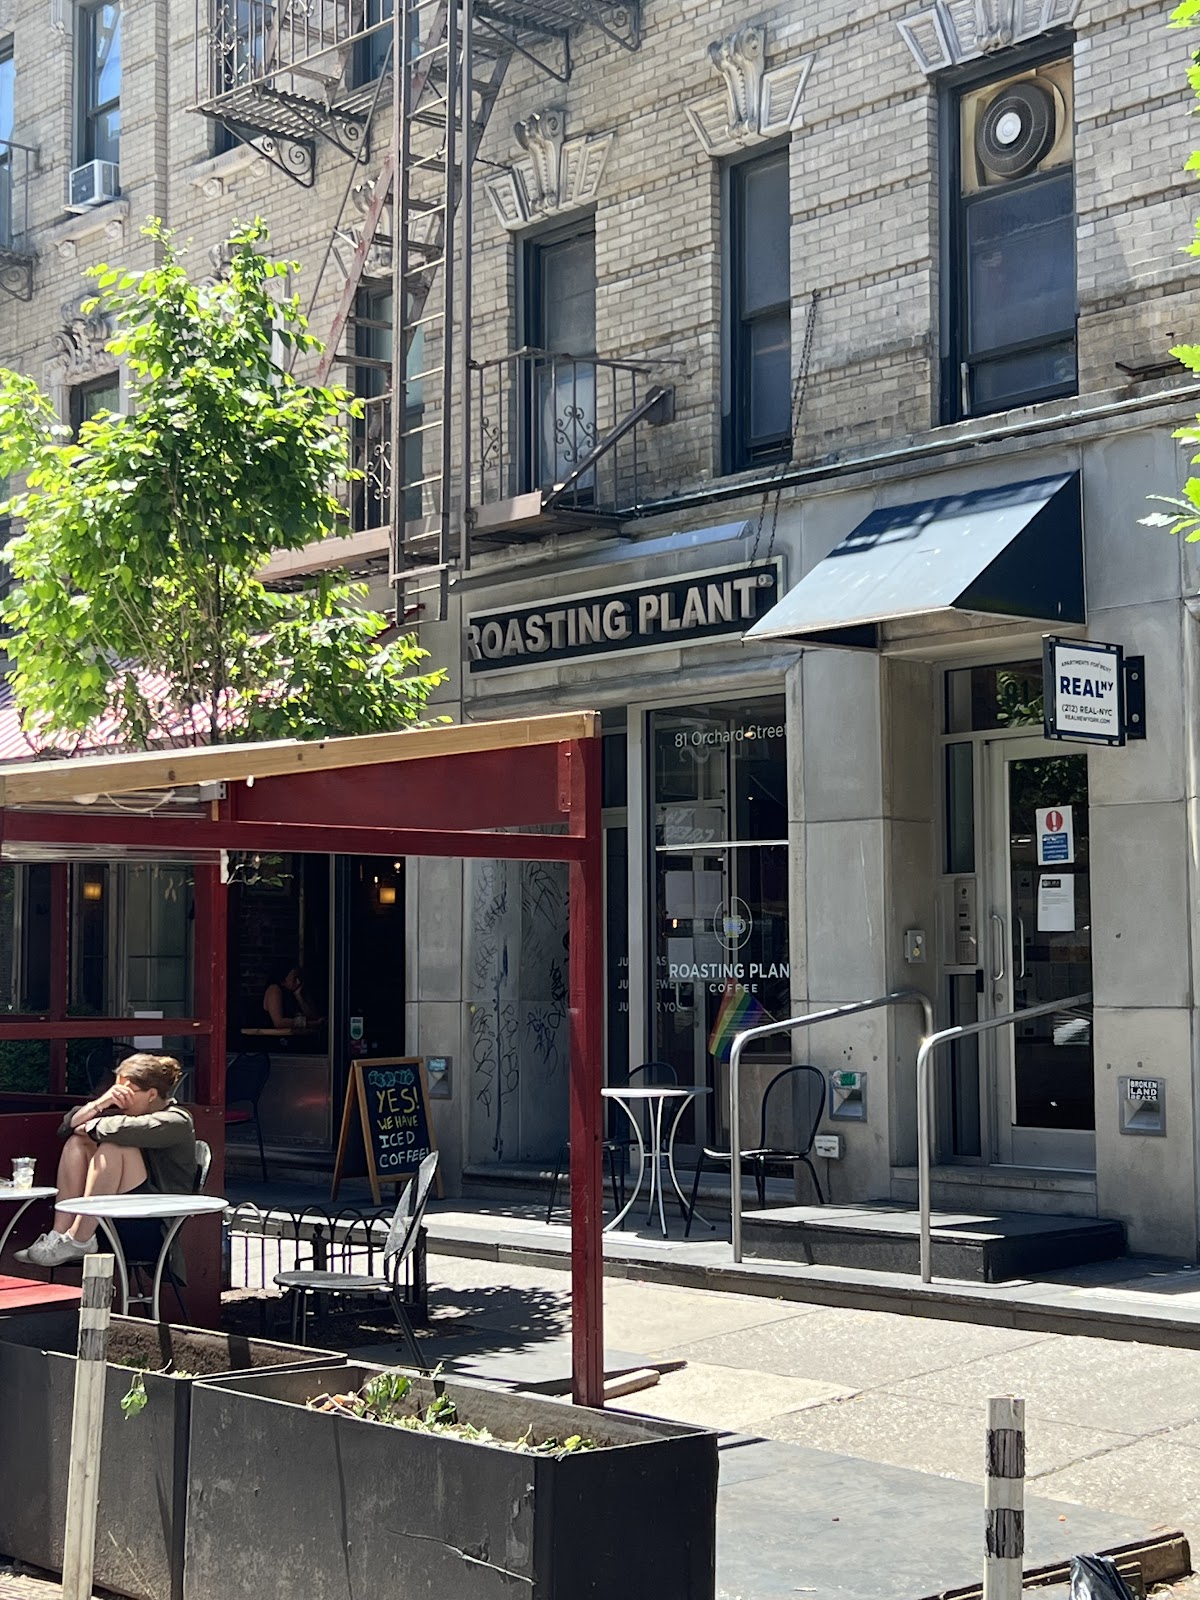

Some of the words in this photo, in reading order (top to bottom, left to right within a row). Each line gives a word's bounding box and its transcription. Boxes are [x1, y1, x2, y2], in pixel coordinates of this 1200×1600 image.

[462, 601, 632, 661] ROASTING
[1062, 704, 1078, 713] (212)
[1079, 706, 1113, 716] REAL-NYC
[675, 732, 687, 747] 81
[691, 726, 744, 746] Orchard
[669, 963, 744, 978] ROASTING
[750, 963, 790, 978] PLAN
[709, 983, 758, 993] COFFEE
[1130, 1080, 1157, 1088] BROKEN
[1130, 1087, 1157, 1096] LAND
[376, 1086, 420, 1113] YES!
[377, 1116, 394, 1131] WE
[394, 1115, 419, 1129] HAVE
[379, 1131, 415, 1149] ICED
